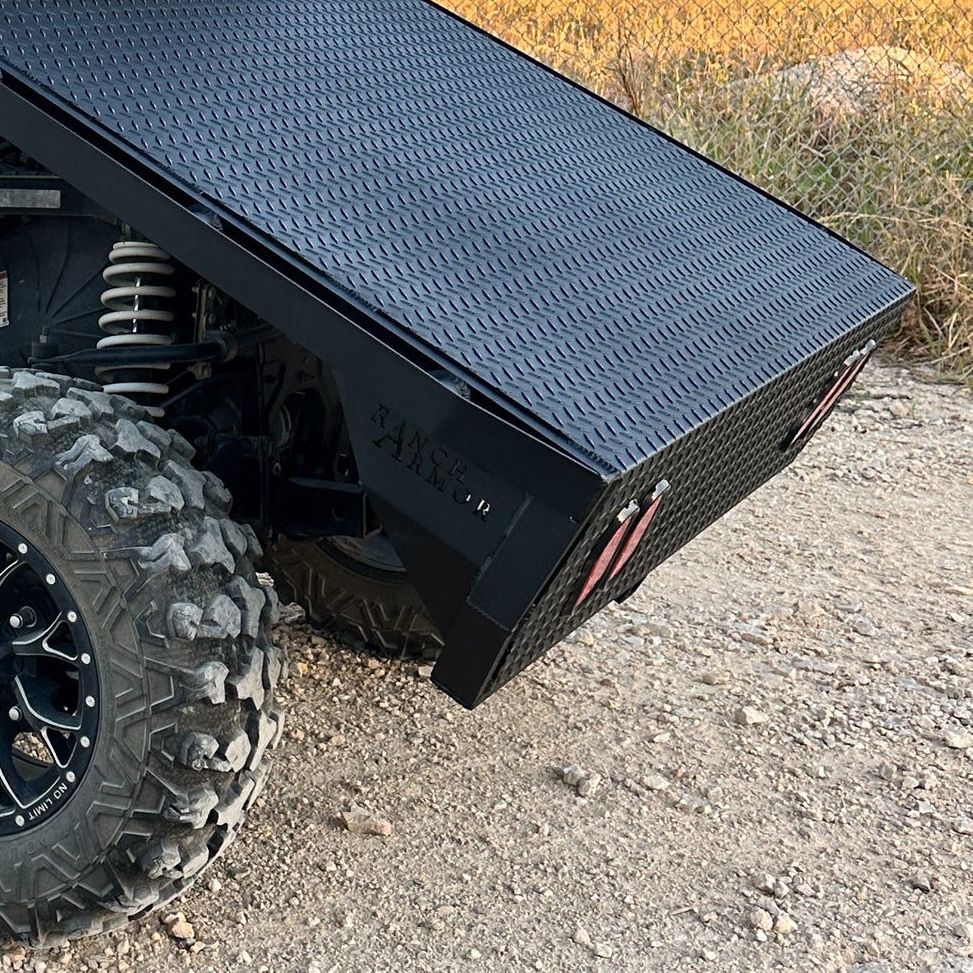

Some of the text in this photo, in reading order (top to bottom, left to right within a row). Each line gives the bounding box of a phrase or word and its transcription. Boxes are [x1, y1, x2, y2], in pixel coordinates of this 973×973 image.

[370, 403, 468, 483] RANCH
[372, 421, 491, 523] ARMOR
[28, 782, 68, 821] NO LIMIT
